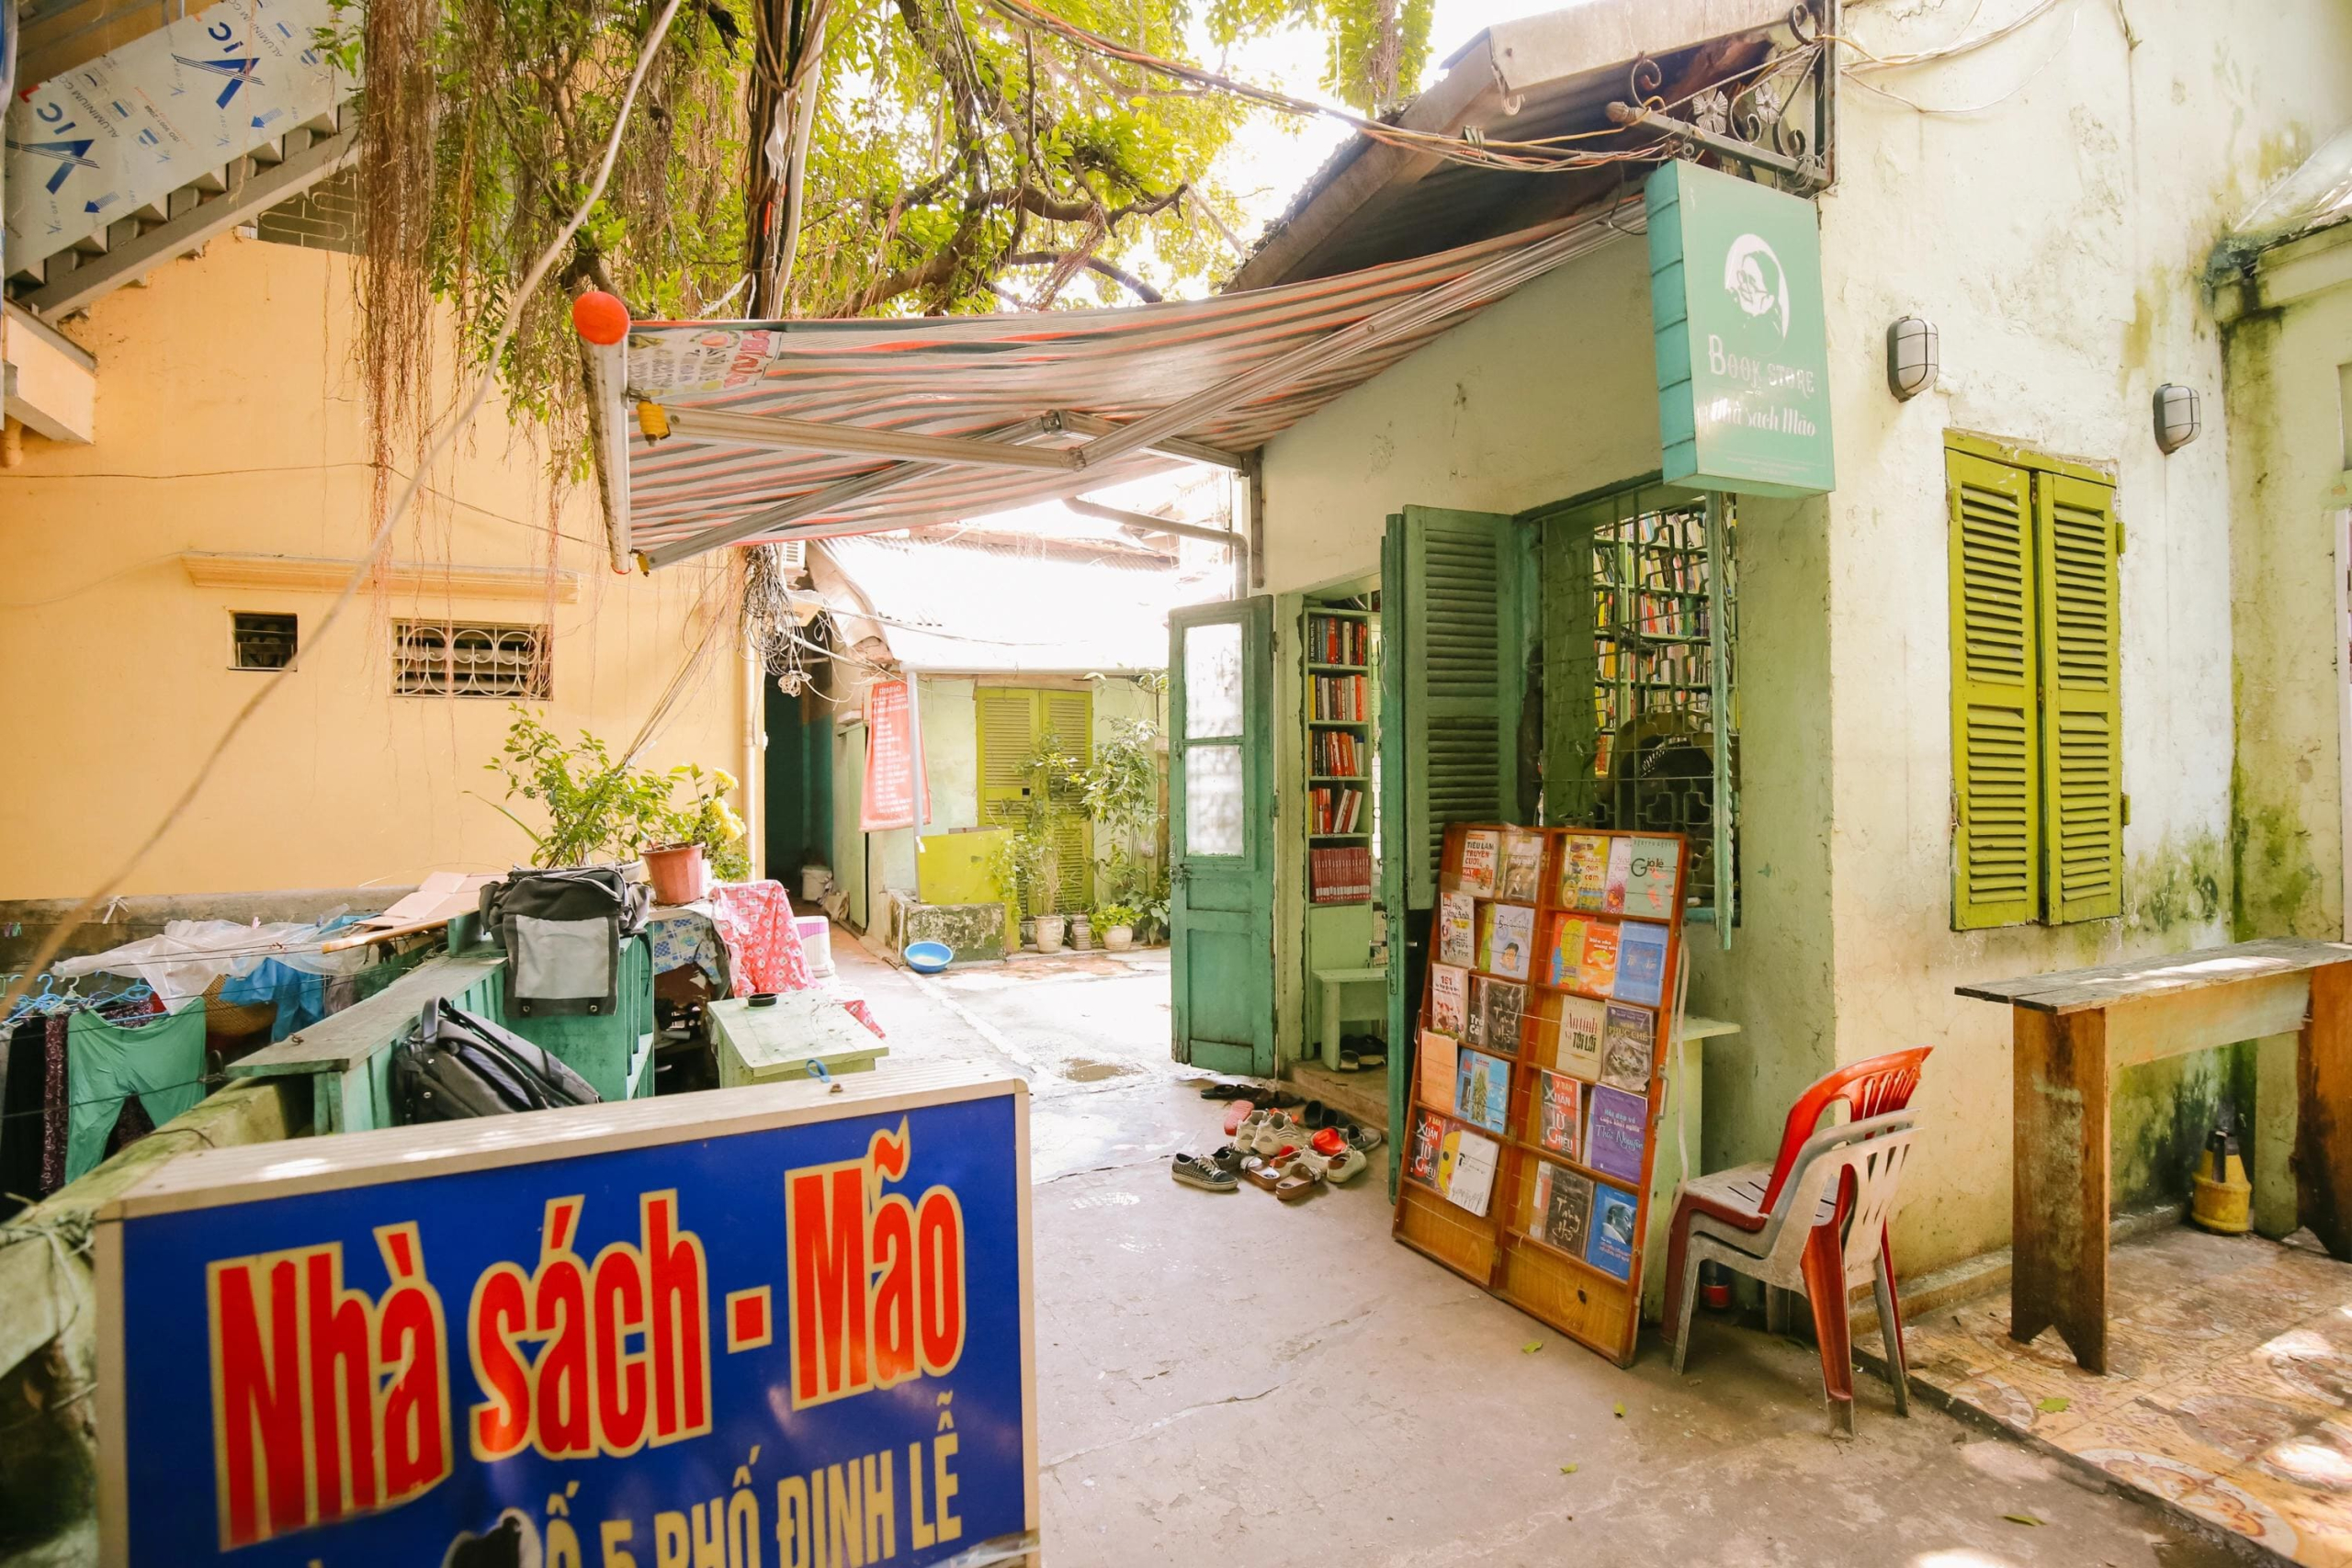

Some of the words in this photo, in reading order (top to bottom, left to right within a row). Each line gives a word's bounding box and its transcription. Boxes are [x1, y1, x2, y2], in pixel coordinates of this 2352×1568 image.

[71, 91, 119, 139] ALUMINIUM
[206, 1220, 453, 1553] Nhà
[469, 1189, 712, 1461] sách
[785, 1114, 967, 1413] Mão
[908, 1391, 963, 1550] LỄ
